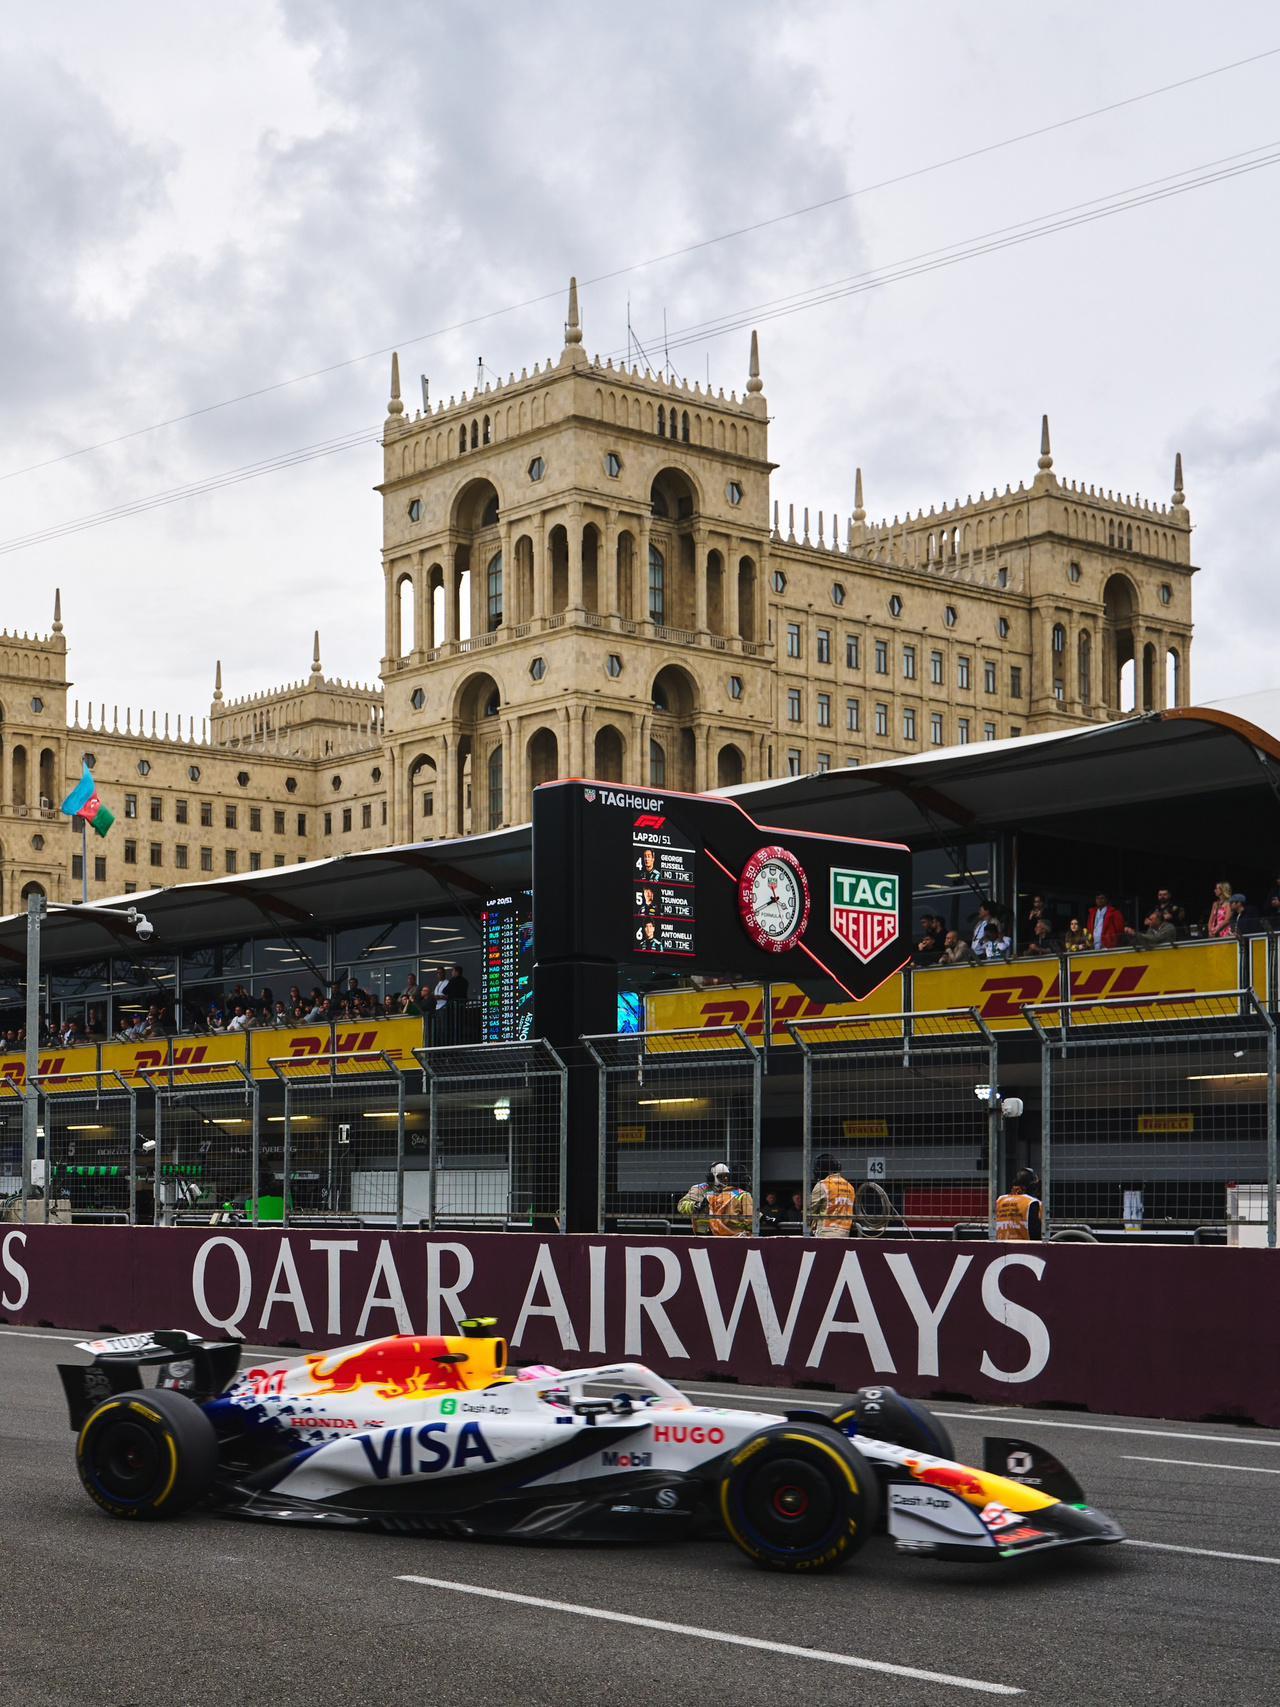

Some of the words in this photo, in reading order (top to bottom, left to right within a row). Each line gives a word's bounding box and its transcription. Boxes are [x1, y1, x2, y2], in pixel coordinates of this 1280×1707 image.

[599, 791, 664, 811] TAGHeuer
[636, 858, 643, 871] 4
[661, 855, 683, 863] GEORGE
[661, 863, 684, 871] RUSSELL
[745, 865, 756, 879] 50
[675, 873, 690, 881] TIME
[743, 889, 750, 903] 45
[837, 875, 893, 907] TAG
[636, 892, 643, 905] 5
[661, 897, 688, 905] TSUNODA
[664, 906, 672, 914] NO
[675, 907, 690, 915] TIME
[636, 927, 643, 940] 6
[661, 931, 693, 940] ANTONELLI
[836, 910, 895, 956] HEUER
[664, 940, 672, 948] NO
[675, 941, 690, 949] TIME
[968, 965, 1155, 1021] DHL
[287, 1031, 380, 1067] DHL
[135, 1046, 210, 1078] DHL
[1, 1058, 66, 1088] DHL
[848, 1123, 884, 1135] PIRELLI
[1142, 1117, 1191, 1130] PIRELLI
[68, 1142, 76, 1156] 5
[199, 1141, 212, 1153] 27
[869, 1161, 884, 1174] 43
[192, 1236, 475, 1344] QATAR
[509, 1243, 1051, 1384] AIRWAYS
[460, 1403, 490, 1414] Cash
[493, 1403, 511, 1415] App
[290, 1418, 358, 1429] HONDA
[653, 1425, 726, 1445] HUGO
[350, 1421, 498, 1480] VISA
[601, 1452, 653, 1467] Mobil
[891, 1494, 923, 1506] Cash
[925, 1496, 951, 1510] App
